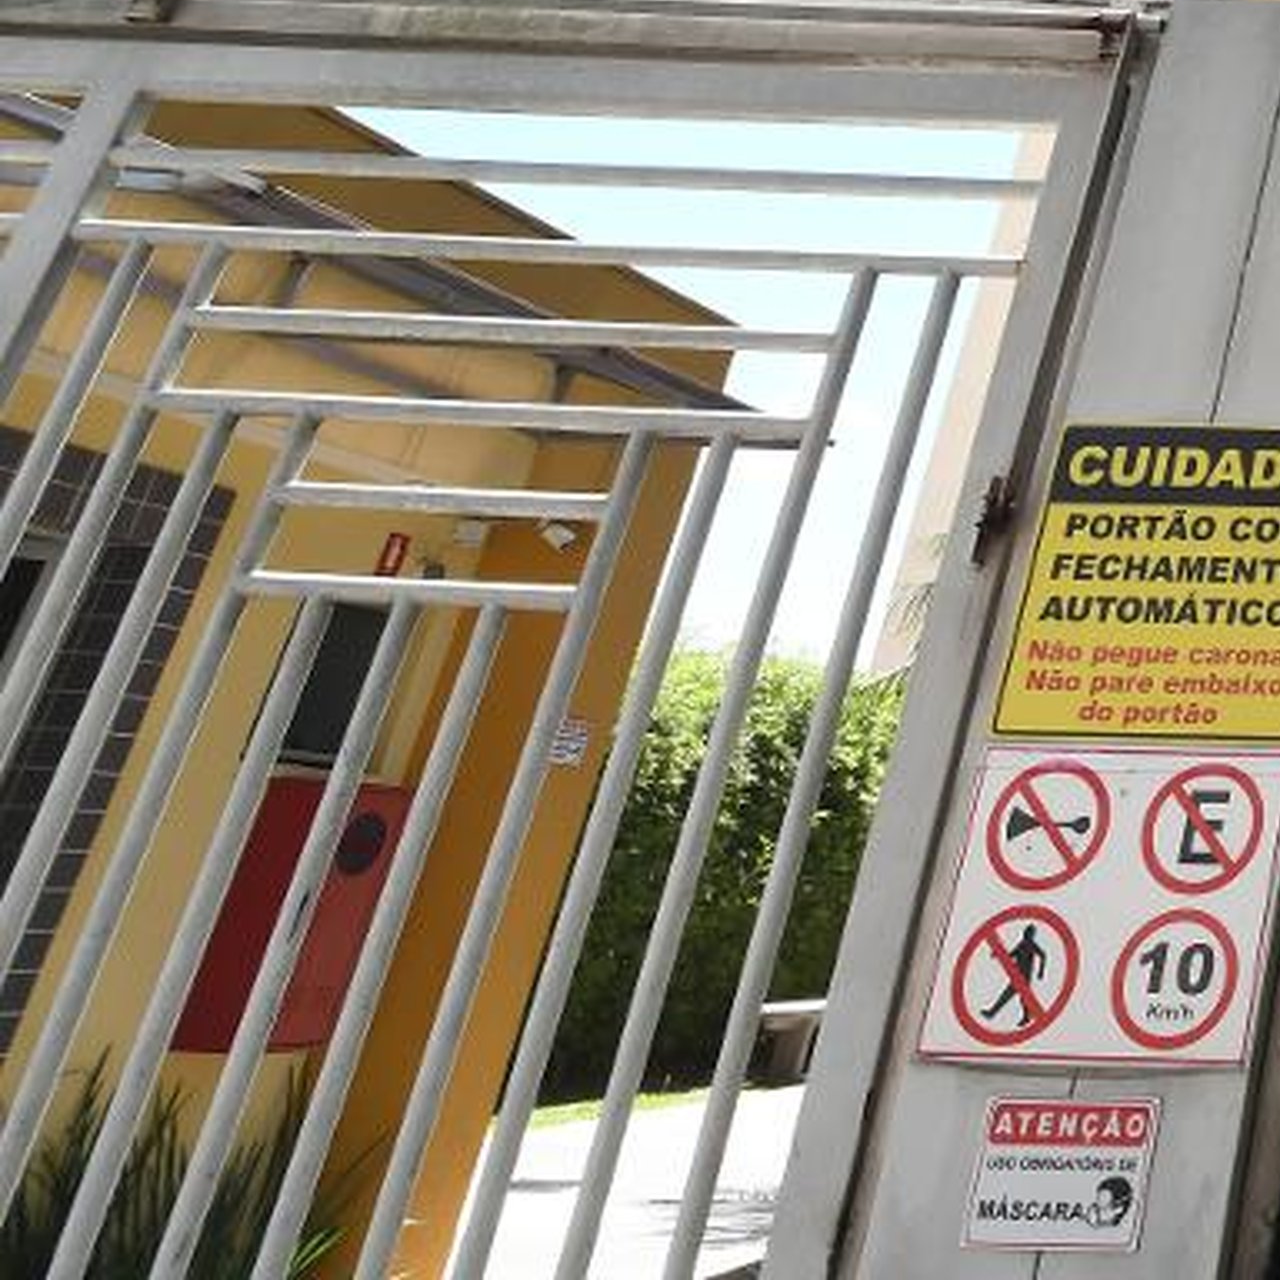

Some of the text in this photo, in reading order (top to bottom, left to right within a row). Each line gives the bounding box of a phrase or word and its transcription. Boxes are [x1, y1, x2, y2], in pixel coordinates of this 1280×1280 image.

[1065, 510, 1216, 540] PORTÃO
[1027, 639, 1082, 664] Não
[1090, 645, 1179, 668] pegue
[1025, 669, 1081, 692] Não
[1089, 675, 1154, 696] pare
[1078, 701, 1219, 727] do portão
[1177, 789, 1231, 864] E
[1139, 942, 1214, 995] 10
[994, 1110, 1145, 1143] ATENÇÃO
[977, 1193, 1087, 1221] MÁSCARA
